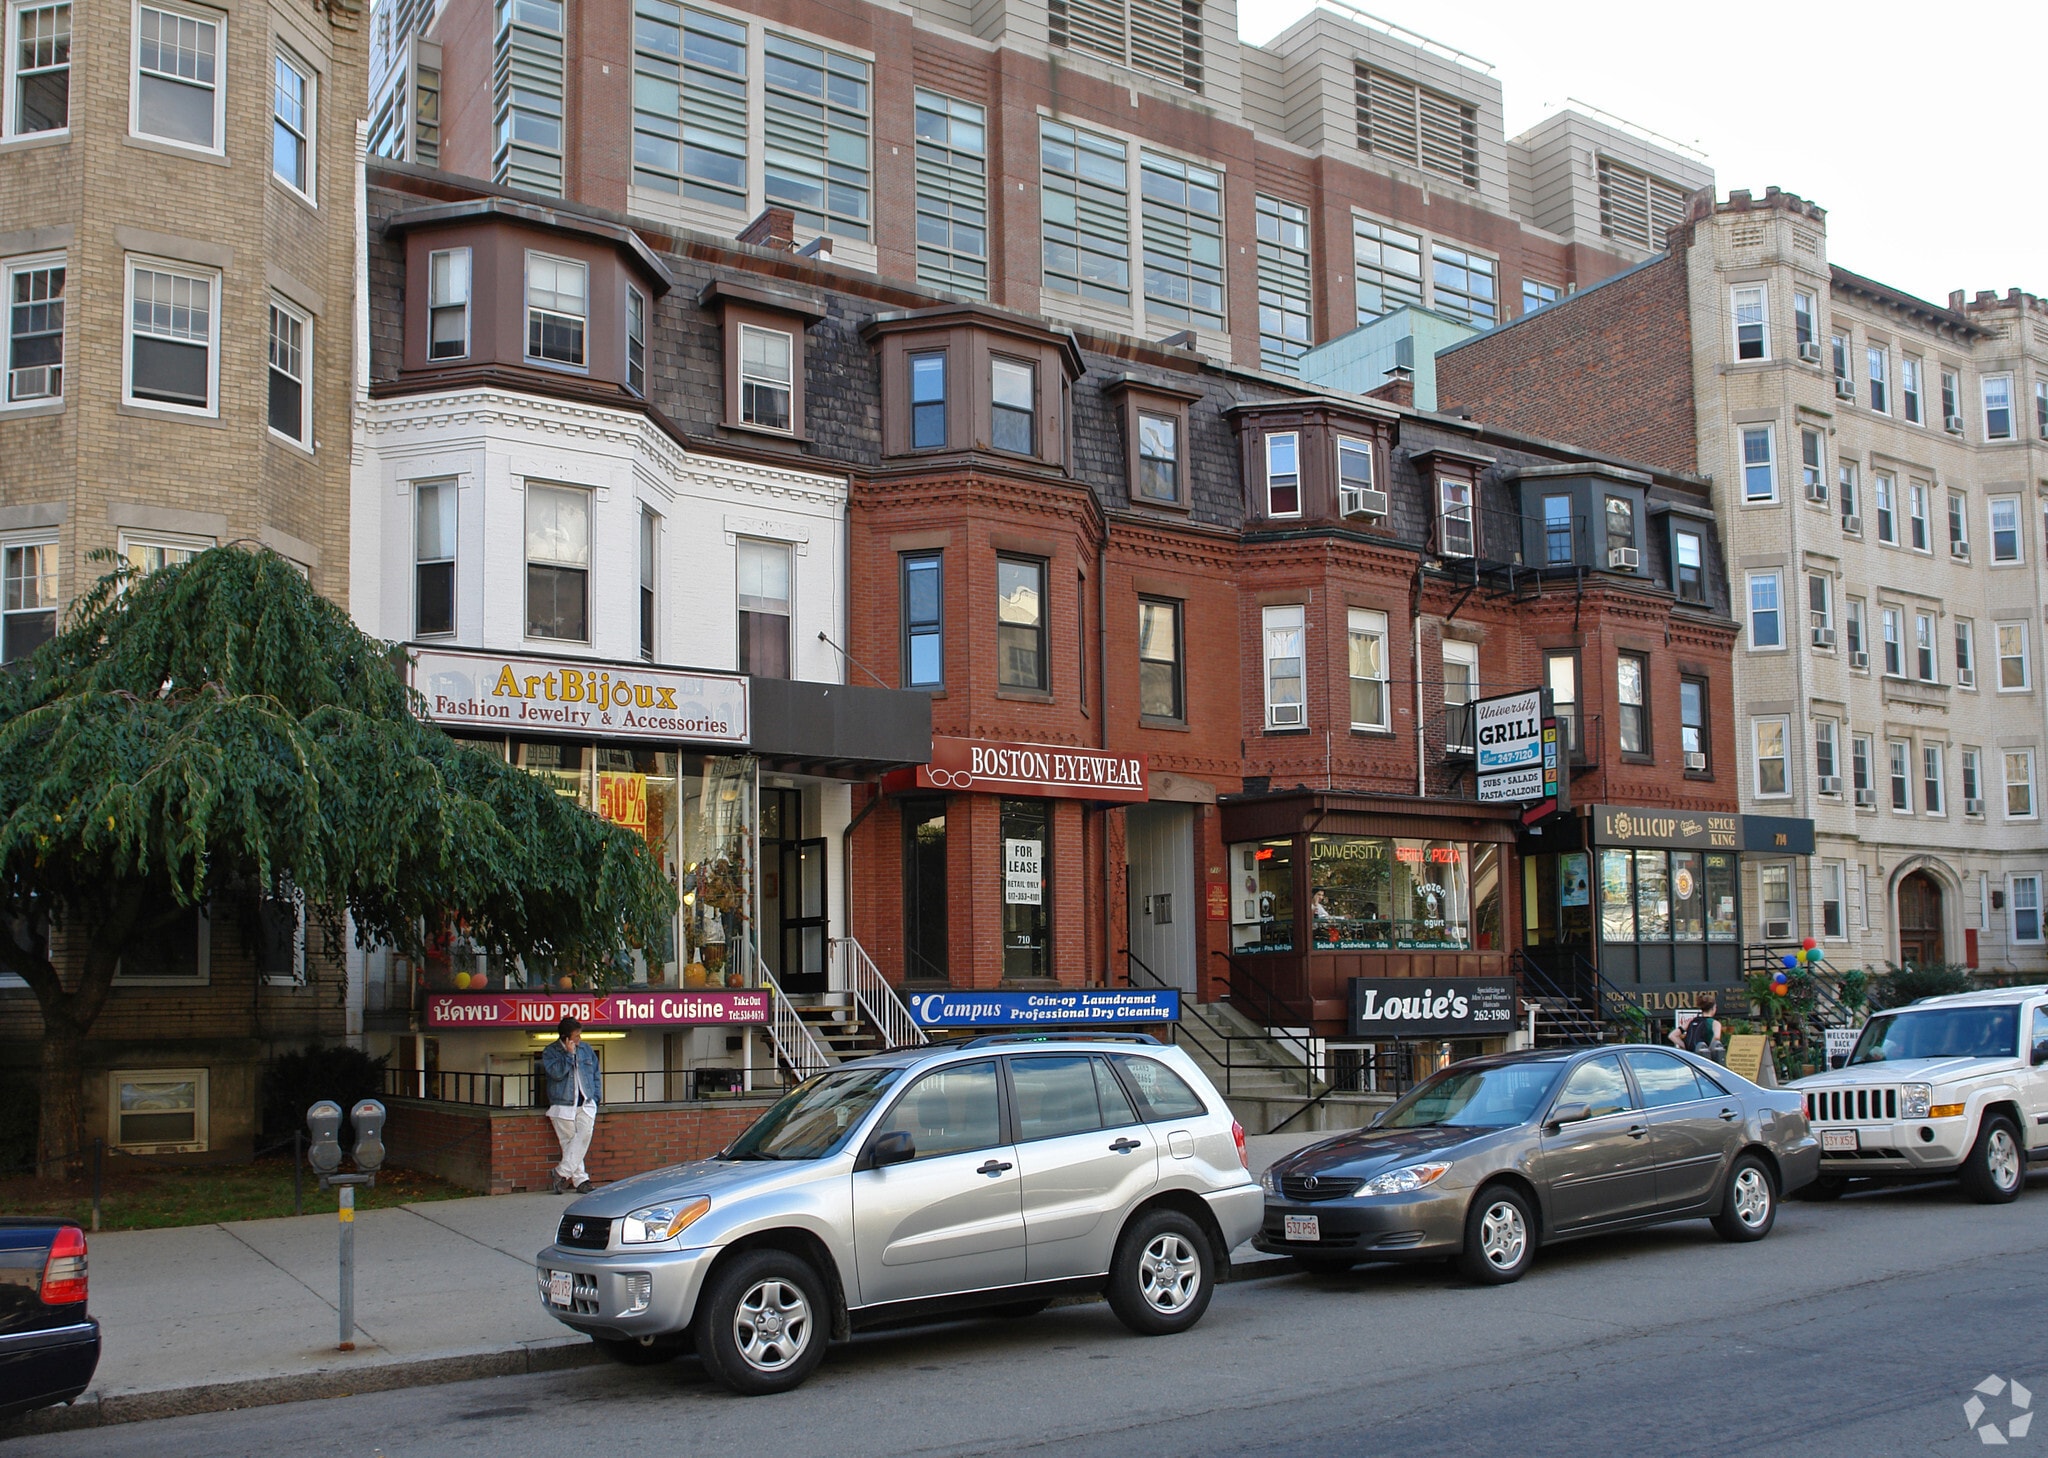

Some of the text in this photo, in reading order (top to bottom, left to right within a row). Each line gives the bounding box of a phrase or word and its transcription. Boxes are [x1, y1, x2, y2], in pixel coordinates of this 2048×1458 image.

[492, 664, 678, 711] ArtBijoux
[435, 695, 727, 733] Fashion Jewelry & Accessories
[1480, 698, 1536, 720] University
[1479, 718, 1539, 745] GRILL
[1497, 750, 1533, 763] 247-7120
[1545, 729, 1555, 793] PIZZA
[971, 747, 1142, 786] BOSTON EYEWEAR
[1483, 773, 1538, 788] SUBS SALADS
[600, 776, 645, 822] 50%
[1481, 785, 1541, 800] PASTA CALZONE
[1708, 817, 1735, 830] SPICE
[1711, 833, 1735, 846] KING
[1775, 833, 1787, 846] 714
[1015, 845, 1033, 857] FOR
[1314, 844, 1383, 860] UNIVERSITY
[1396, 847, 1424, 861] GRILL
[1432, 848, 1461, 862] PIZZA
[1009, 861, 1038, 873] LEASE
[1008, 881, 1025, 889] RETAIL
[1017, 935, 1030, 944] 710
[733, 996, 761, 1006] Take Out
[1028, 994, 1156, 1007] Coin-op Laundramat
[1362, 988, 1469, 1020] Louie's
[521, 1003, 590, 1022] NUD POB
[616, 999, 724, 1019] Thai Cuisine
[920, 994, 1002, 1023] Campus
[1010, 1006, 1169, 1020] Professional Dry Cleaning
[1474, 1009, 1510, 1021] 262-1980
